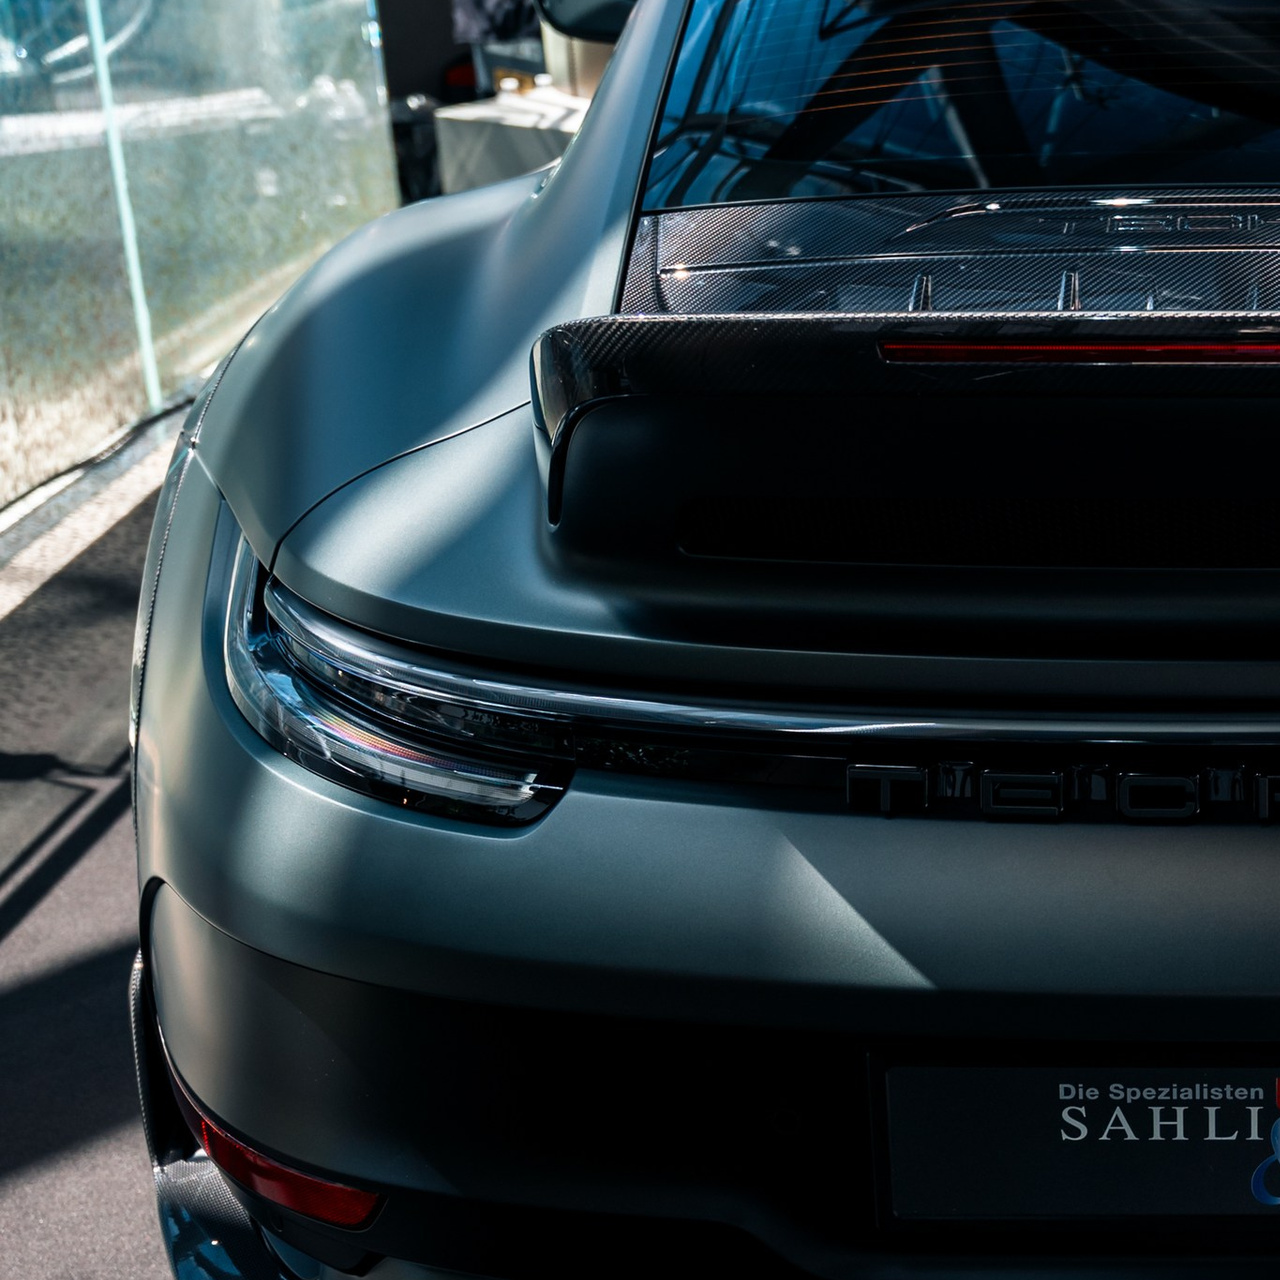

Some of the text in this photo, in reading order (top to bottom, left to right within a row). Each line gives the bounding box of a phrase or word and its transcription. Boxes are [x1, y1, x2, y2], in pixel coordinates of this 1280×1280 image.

[1058, 1083, 1100, 1101] Die
[1108, 1082, 1264, 1104] Spezialisten
[1060, 1105, 1265, 1142] SAHLI
